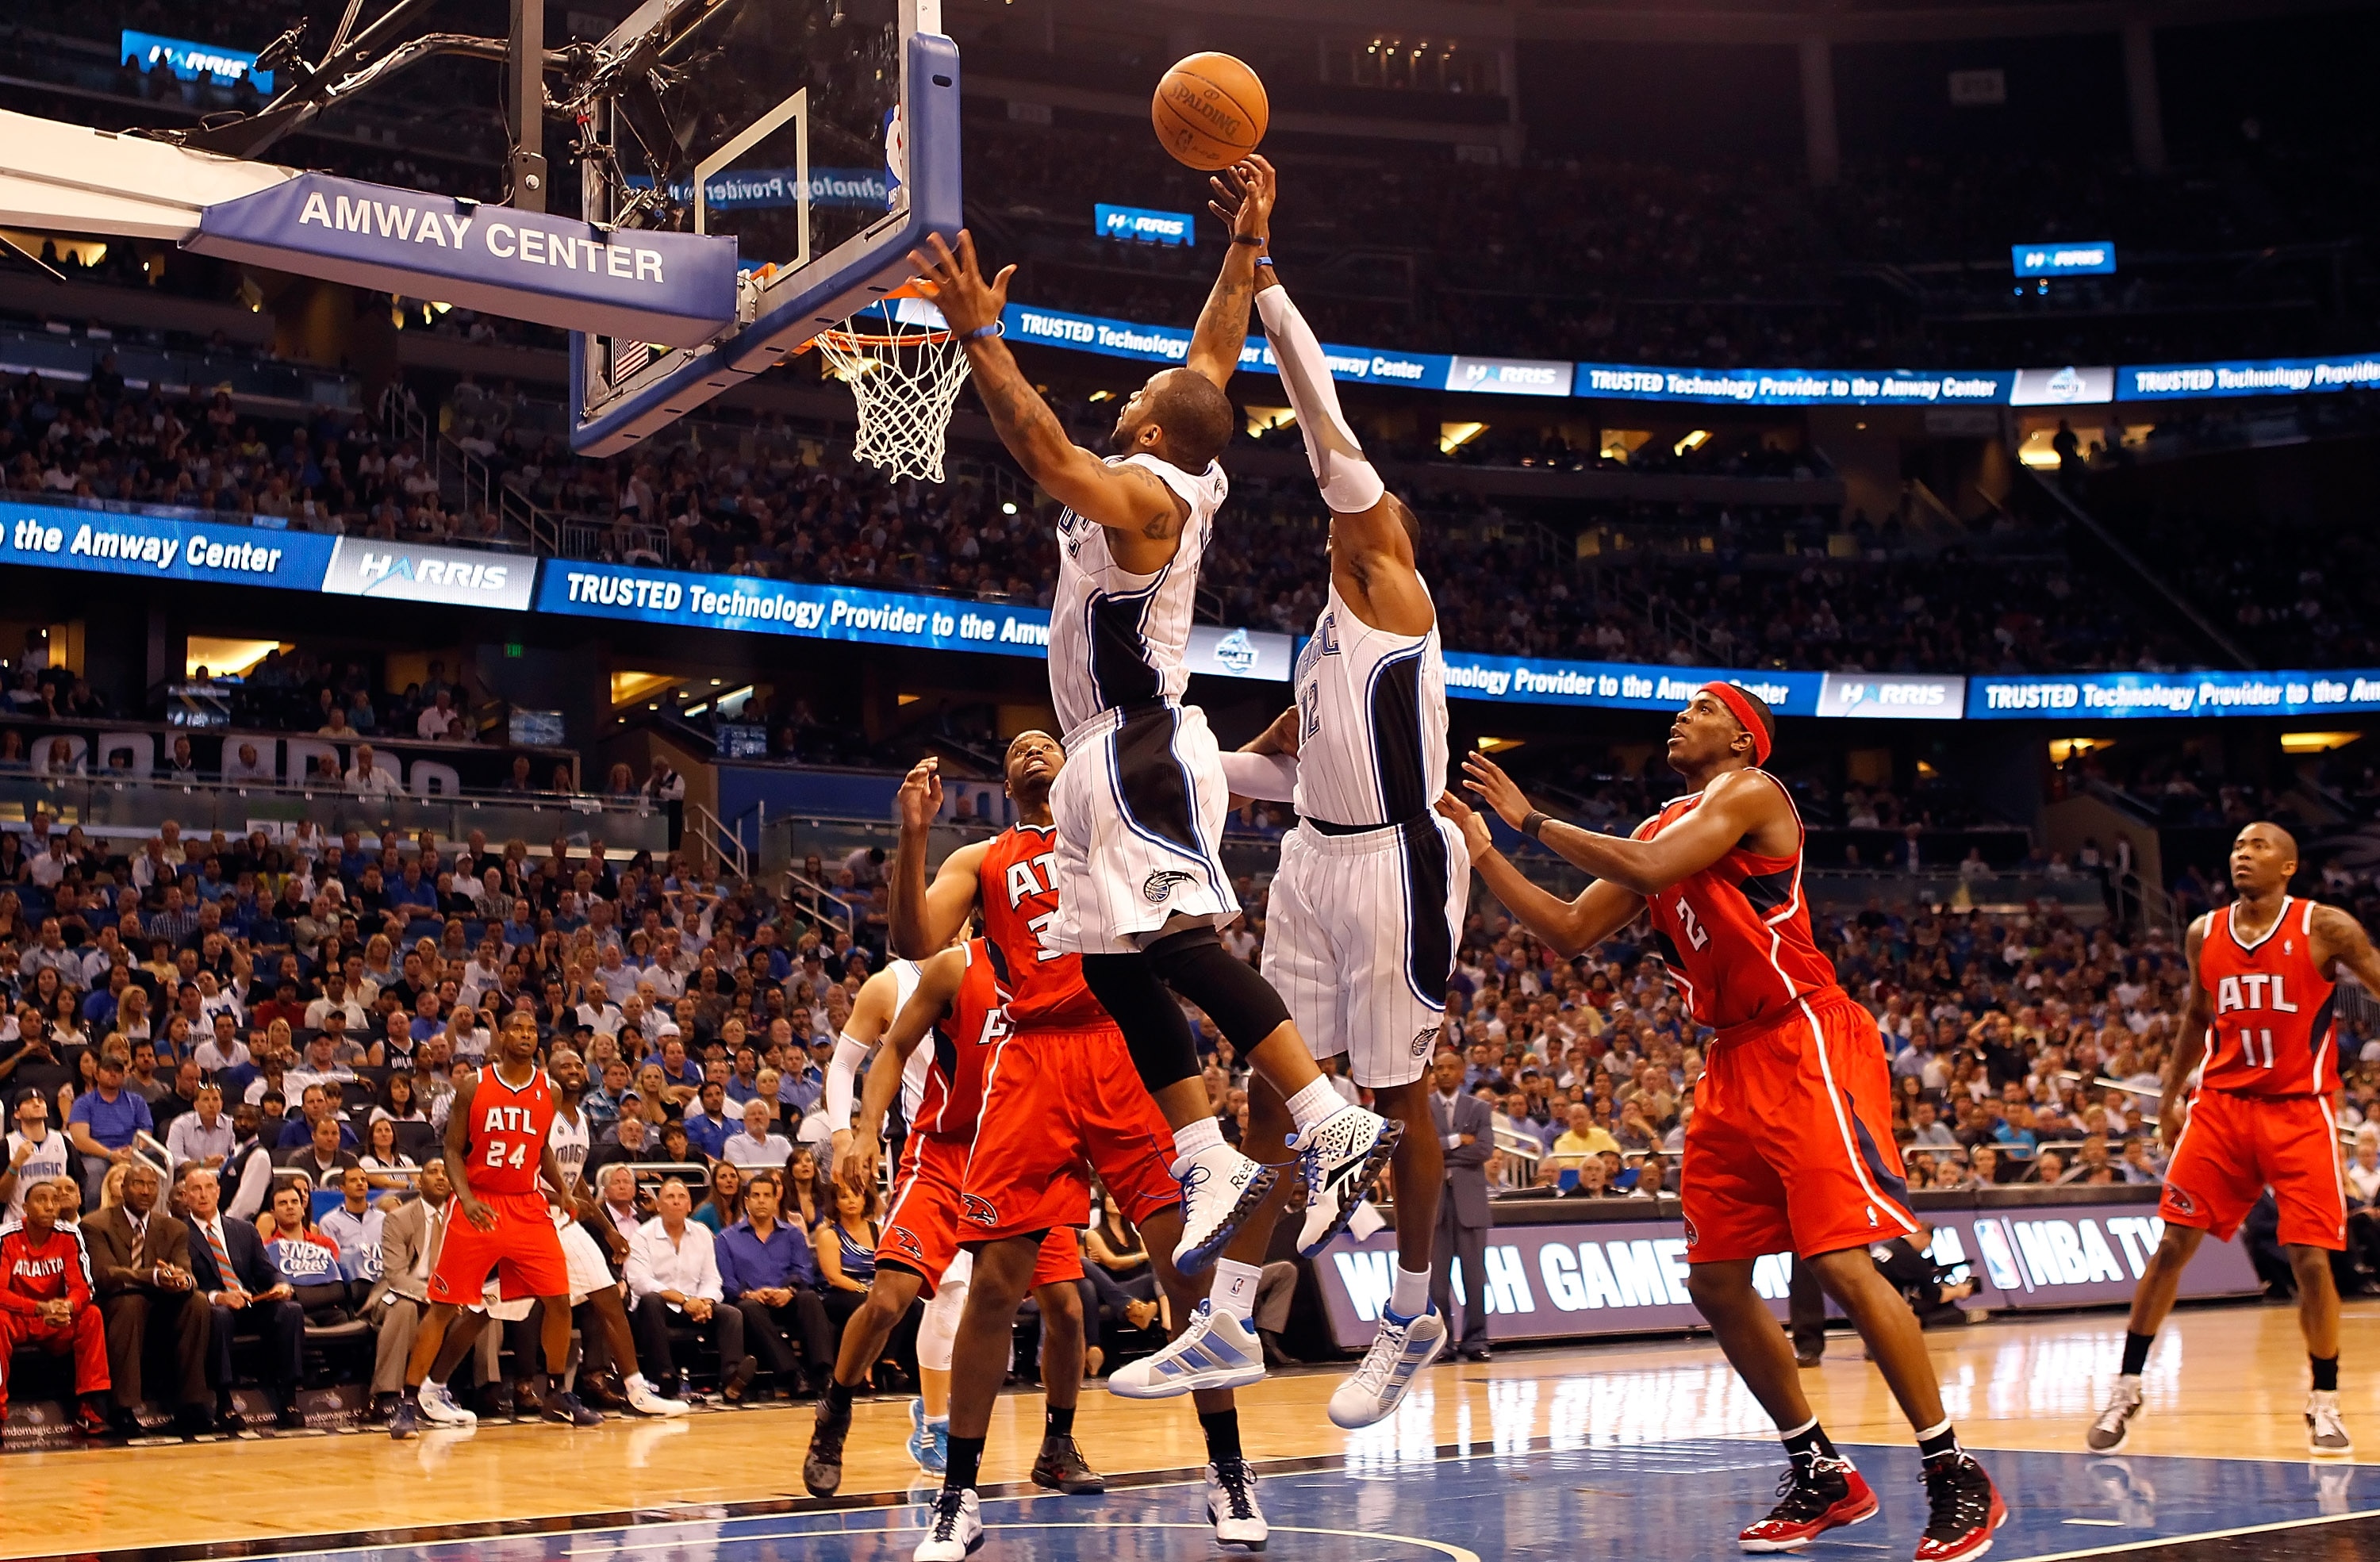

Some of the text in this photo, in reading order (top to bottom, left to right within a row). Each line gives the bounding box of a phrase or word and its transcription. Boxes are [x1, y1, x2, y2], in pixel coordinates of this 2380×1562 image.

[1169, 82, 1241, 138] SPALDING
[298, 191, 665, 283] AMWAY CENTER
[1107, 213, 1184, 236] HARRIS
[1021, 313, 1095, 343] TRUSTED
[1097, 325, 1190, 359] Technology
[1372, 356, 1425, 380] Center
[1467, 364, 1557, 385] HARRIS
[1590, 369, 1998, 401] TRUSTED Technology Provider to the Amway Center
[14, 518, 63, 553] the
[70, 523, 180, 570] Amway
[186, 535, 282, 574] Center
[359, 553, 509, 591] HARRIS
[567, 572, 683, 611] TRUSTED
[689, 585, 826, 630] Technology
[830, 599, 927, 634] Provider
[931, 612, 955, 637] to
[960, 612, 996, 641] the
[1514, 667, 1596, 697] Provider
[1598, 674, 1619, 697] to
[1622, 672, 1653, 699] the
[1839, 681, 1944, 707] HARRIS
[1985, 684, 2079, 710] TRUSTED
[2082, 682, 2196, 712] Technology
[2198, 681, 2283, 706] Provider
[2285, 681, 2309, 704] to
[2311, 678, 2348, 704] the
[1676, 896, 1709, 952] 2
[2217, 973, 2299, 1015] ATL
[2240, 1028, 2274, 1069] 11
[484, 1106, 537, 1136] ATL
[486, 1139, 527, 1170] 24
[279, 1257, 329, 1276] Cares
[2013, 1219, 2125, 1287] NBA
[2106, 1215, 2166, 1281] TV
